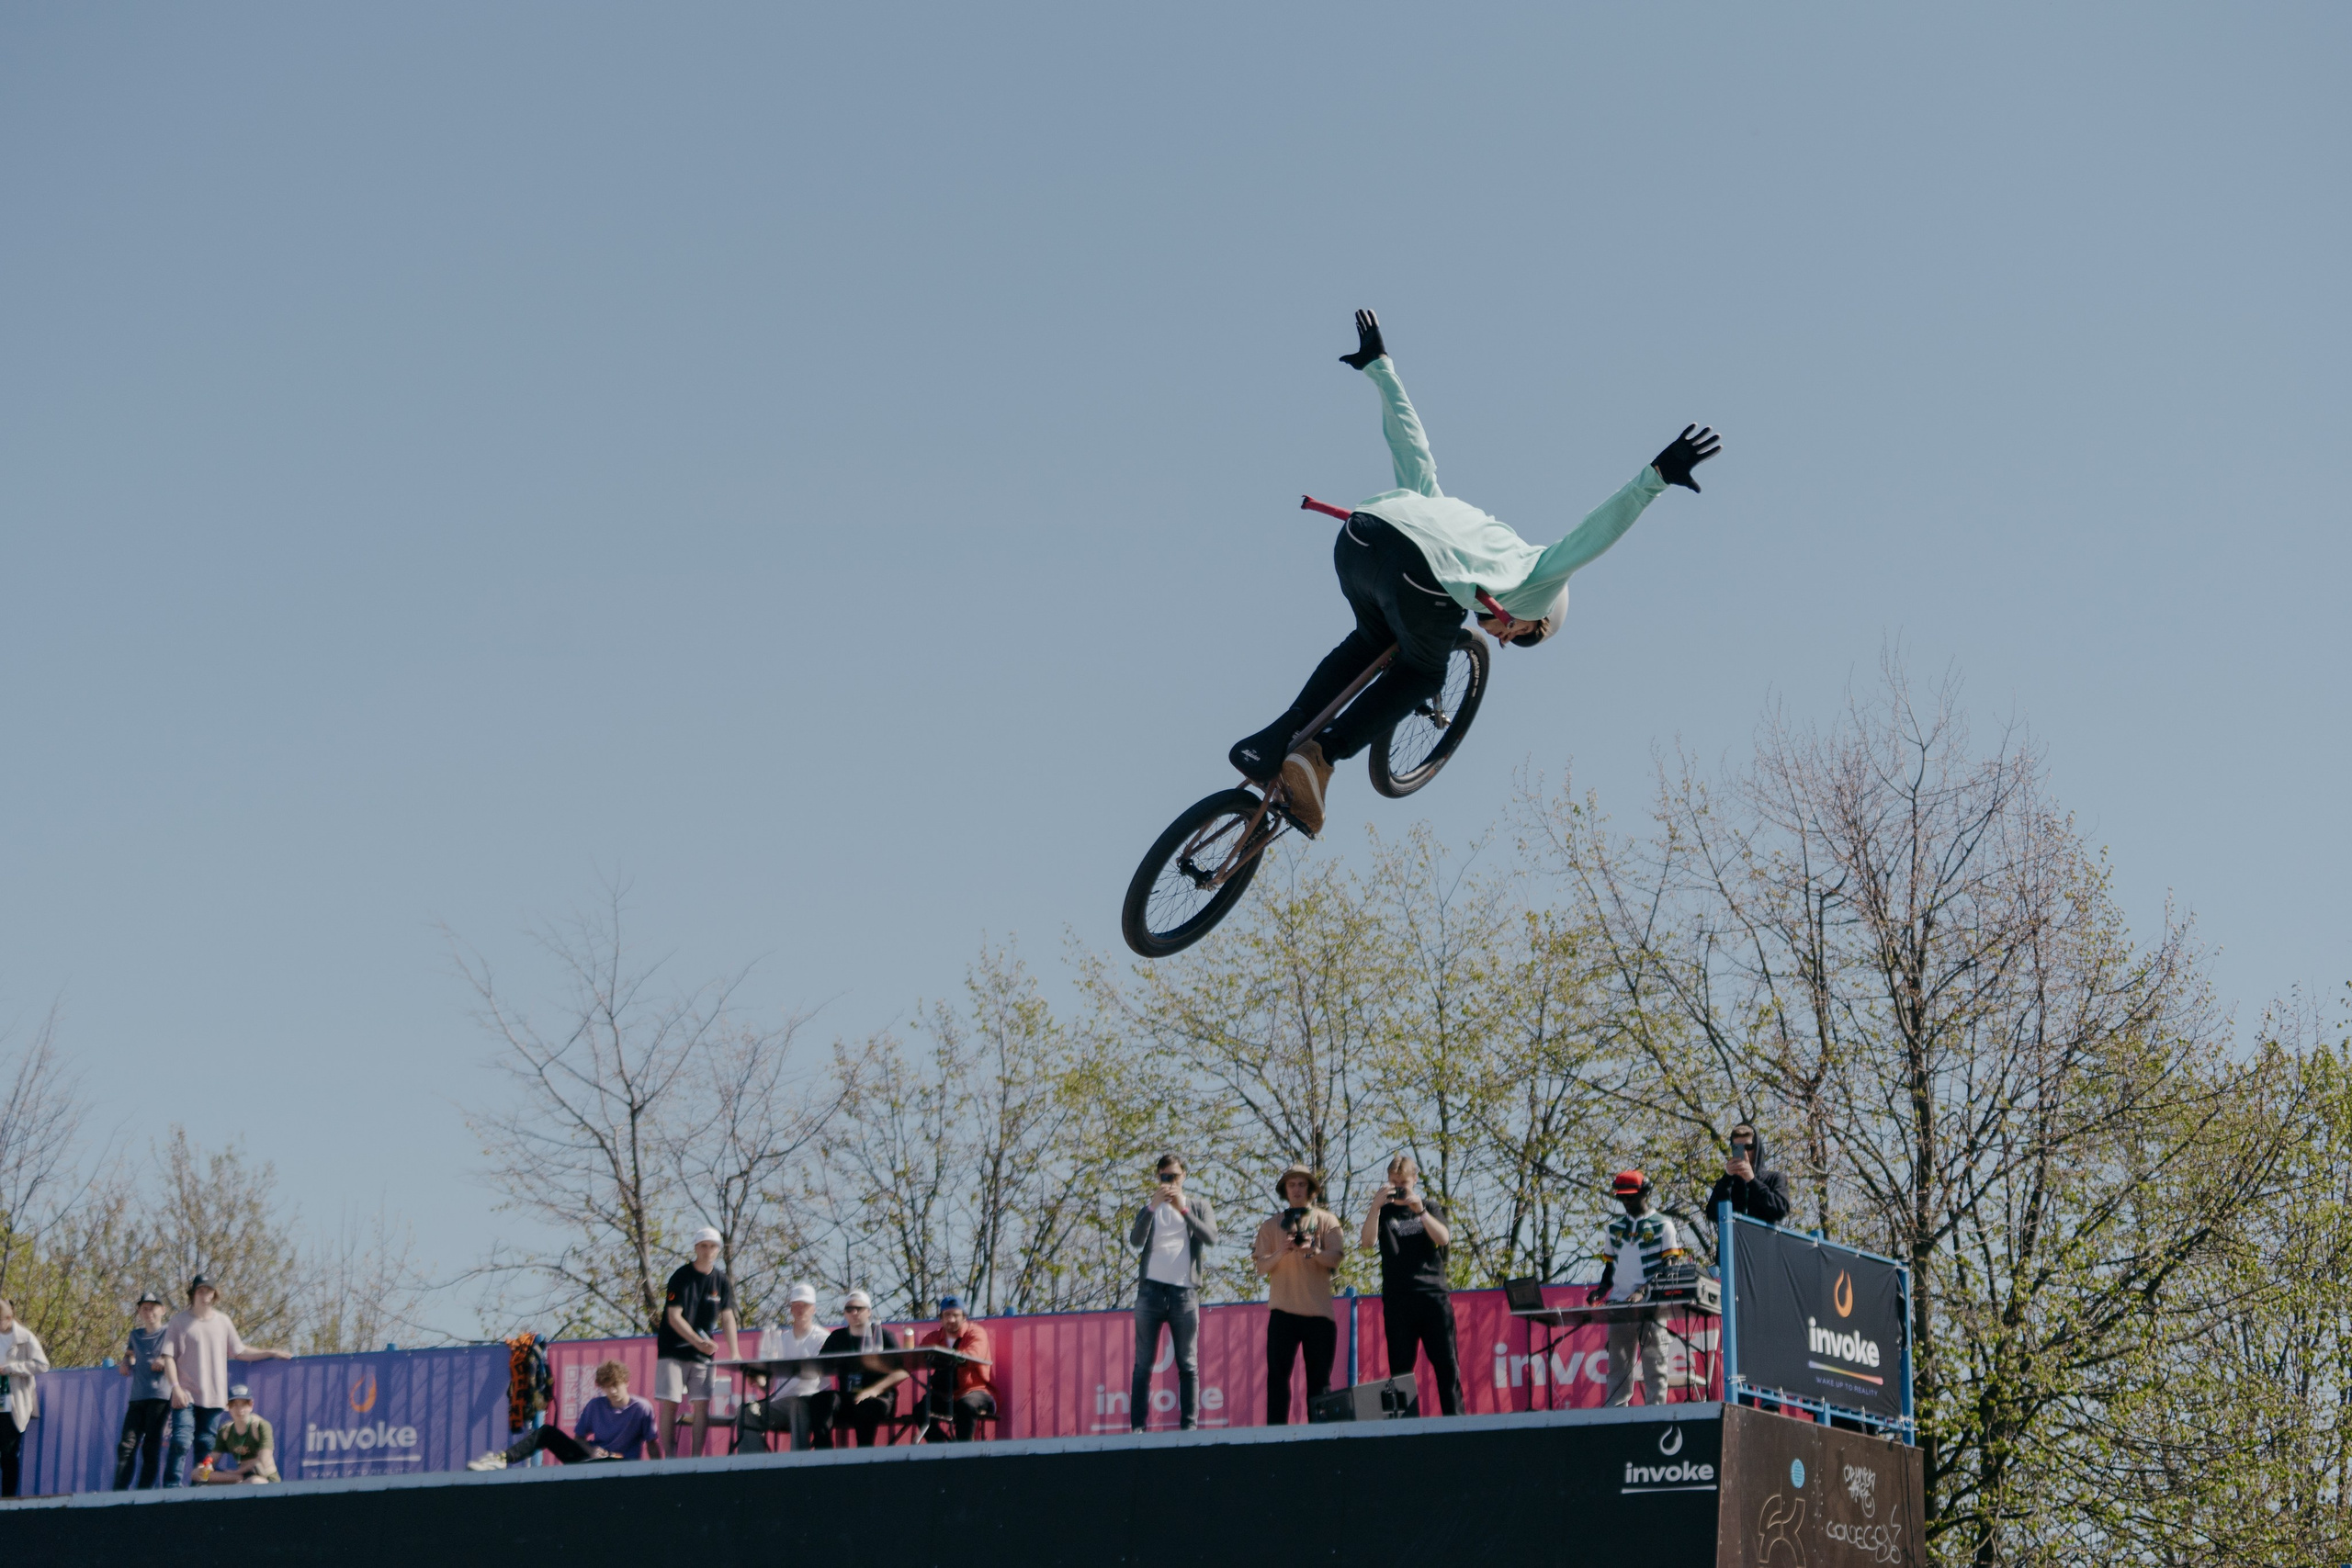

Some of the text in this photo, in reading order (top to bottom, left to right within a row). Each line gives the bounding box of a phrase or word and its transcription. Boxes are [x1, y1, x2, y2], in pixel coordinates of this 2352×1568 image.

[1808, 1315, 1880, 1368] invoke
[1494, 1342, 1697, 1388] invoe
[1096, 1384, 1224, 1415] inoe
[1816, 1376, 1834, 1386] WAKE
[1854, 1385, 1878, 1395] REALITY
[308, 1421, 417, 1451] invoke
[1625, 1461, 1713, 1483] invoke
